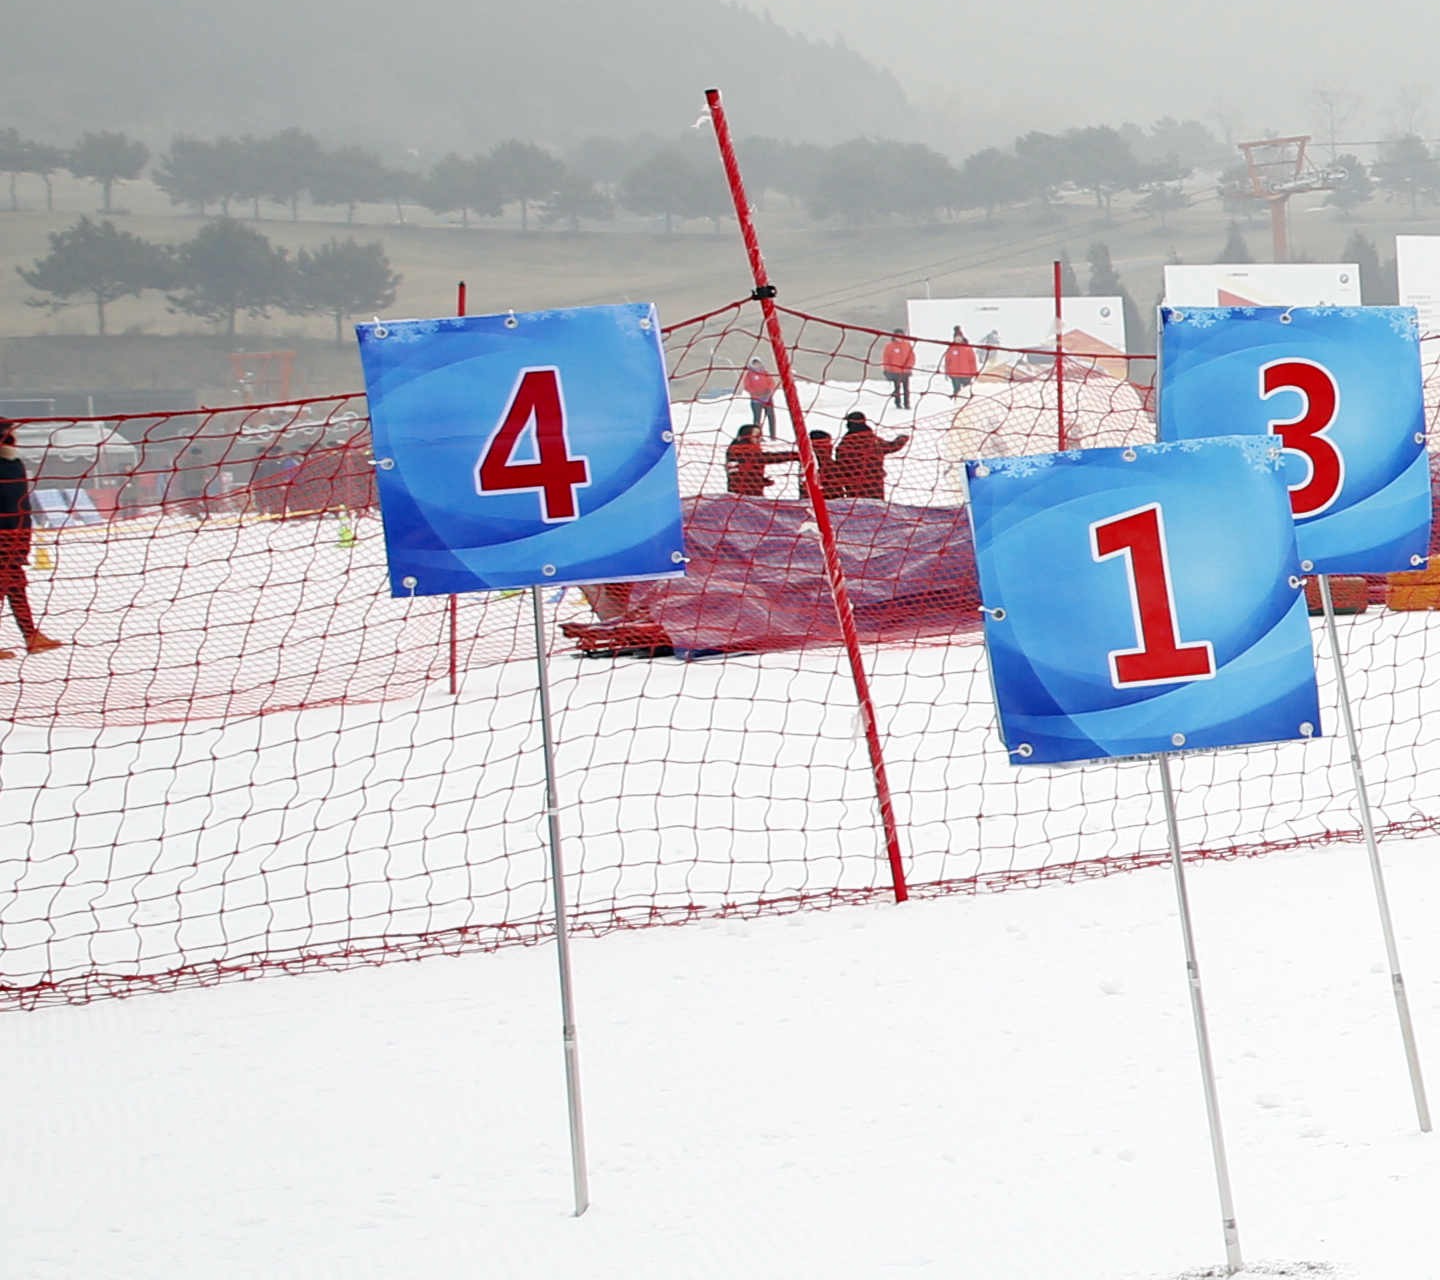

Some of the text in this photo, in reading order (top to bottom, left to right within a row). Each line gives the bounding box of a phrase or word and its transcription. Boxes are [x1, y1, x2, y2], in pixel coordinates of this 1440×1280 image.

[475, 364, 591, 522] 4
[1259, 357, 1345, 518] 3
[1089, 503, 1216, 689] 1
